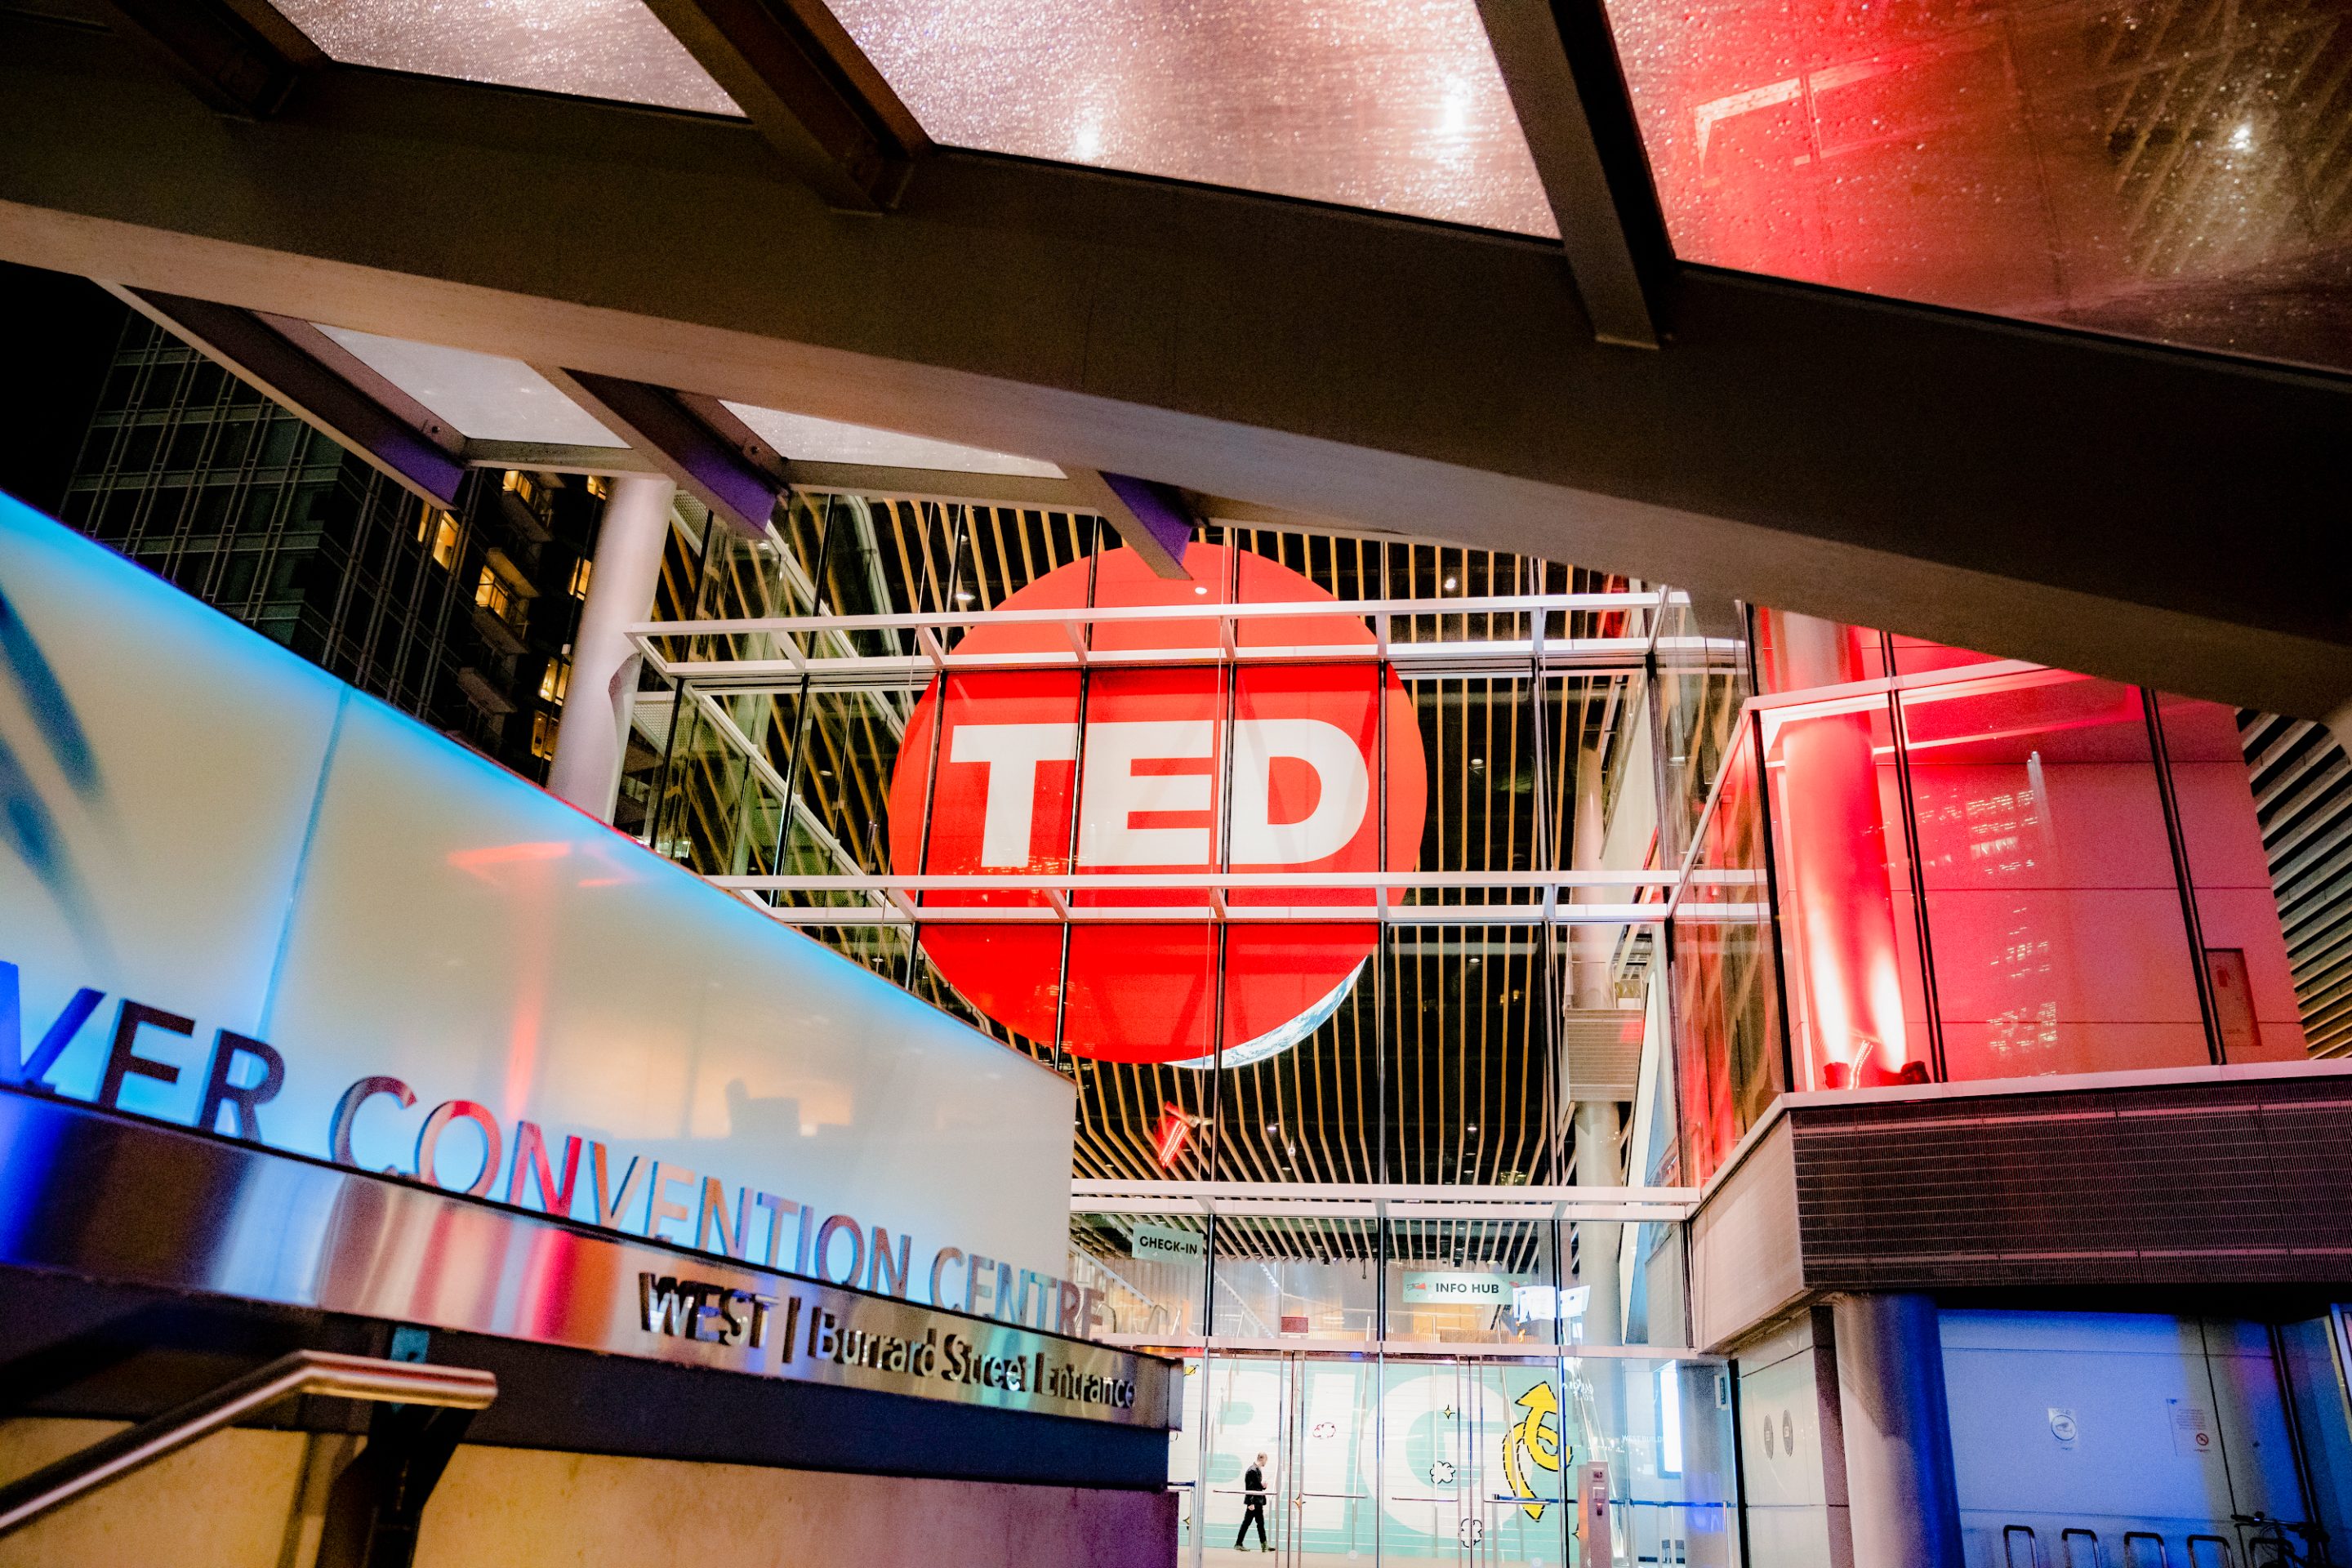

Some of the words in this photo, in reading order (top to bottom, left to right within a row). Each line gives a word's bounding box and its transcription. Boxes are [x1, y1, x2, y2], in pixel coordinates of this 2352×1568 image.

[951, 719, 1370, 868] TED
[329, 1076, 912, 1297] CONVENTION
[929, 1246, 1105, 1341] CENTRE
[1139, 1236, 1197, 1254] CHECK-IN
[639, 1272, 779, 1348] WEST
[808, 1306, 937, 1377] Burrard
[941, 1334, 1031, 1392] Street
[1034, 1352, 1137, 1409] Entrance
[1436, 1282, 1467, 1294] INFO
[1472, 1283, 1499, 1294] HUB
